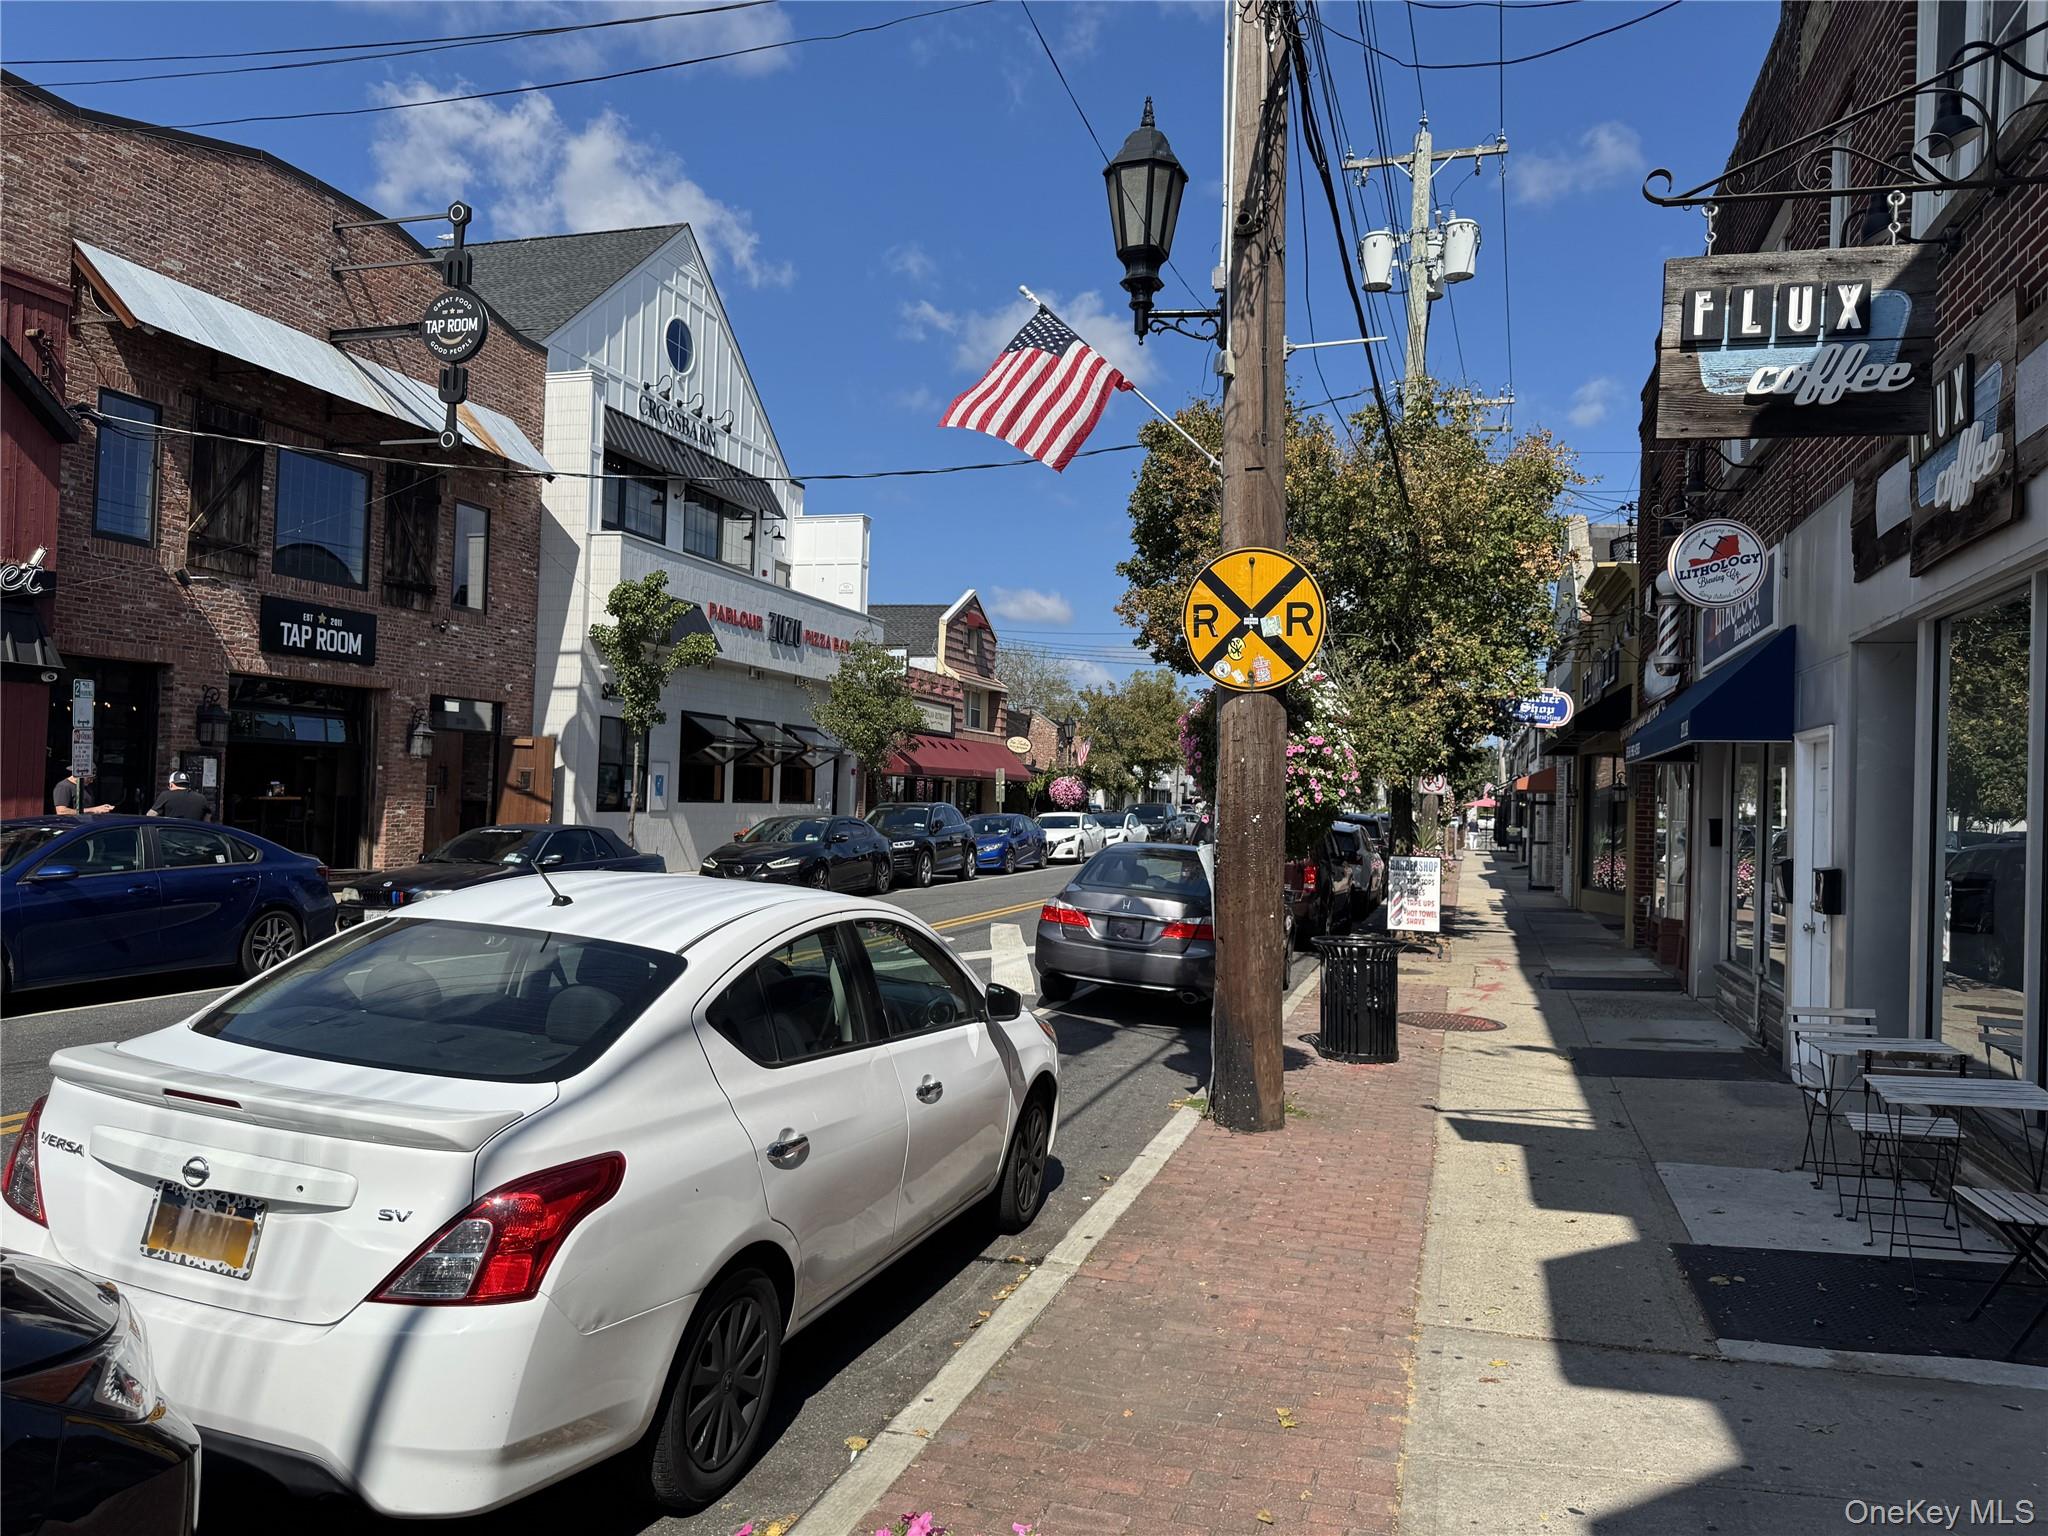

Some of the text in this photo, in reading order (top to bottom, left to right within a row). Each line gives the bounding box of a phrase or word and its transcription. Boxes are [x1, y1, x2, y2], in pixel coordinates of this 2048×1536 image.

[433, 297, 453, 311] GREAT
[455, 297, 472, 310] FOOD
[1693, 284, 1863, 336] FLUX
[425, 317, 478, 334] TAP ROOM
[431, 338, 473, 355] GOOD PEOPLE
[1746, 343, 1915, 406] coffee
[639, 395, 716, 450] CROSSBARN
[1934, 421, 2006, 512] coffee
[1680, 553, 1761, 580] LITHOLOGY
[1697, 573, 1725, 589] Brewing
[303, 612, 314, 623] EST
[709, 602, 764, 632] PARLOUR
[768, 612, 803, 648] ZUZU
[805, 629, 832, 650] PIZZA
[1193, 604, 1218, 638] R
[1286, 602, 1314, 636] R
[280, 621, 362, 656] TAP ROOM
[1519, 702, 1555, 715] Shop
[42, 1131, 85, 1157] VERSA
[378, 1209, 413, 1222] SV
